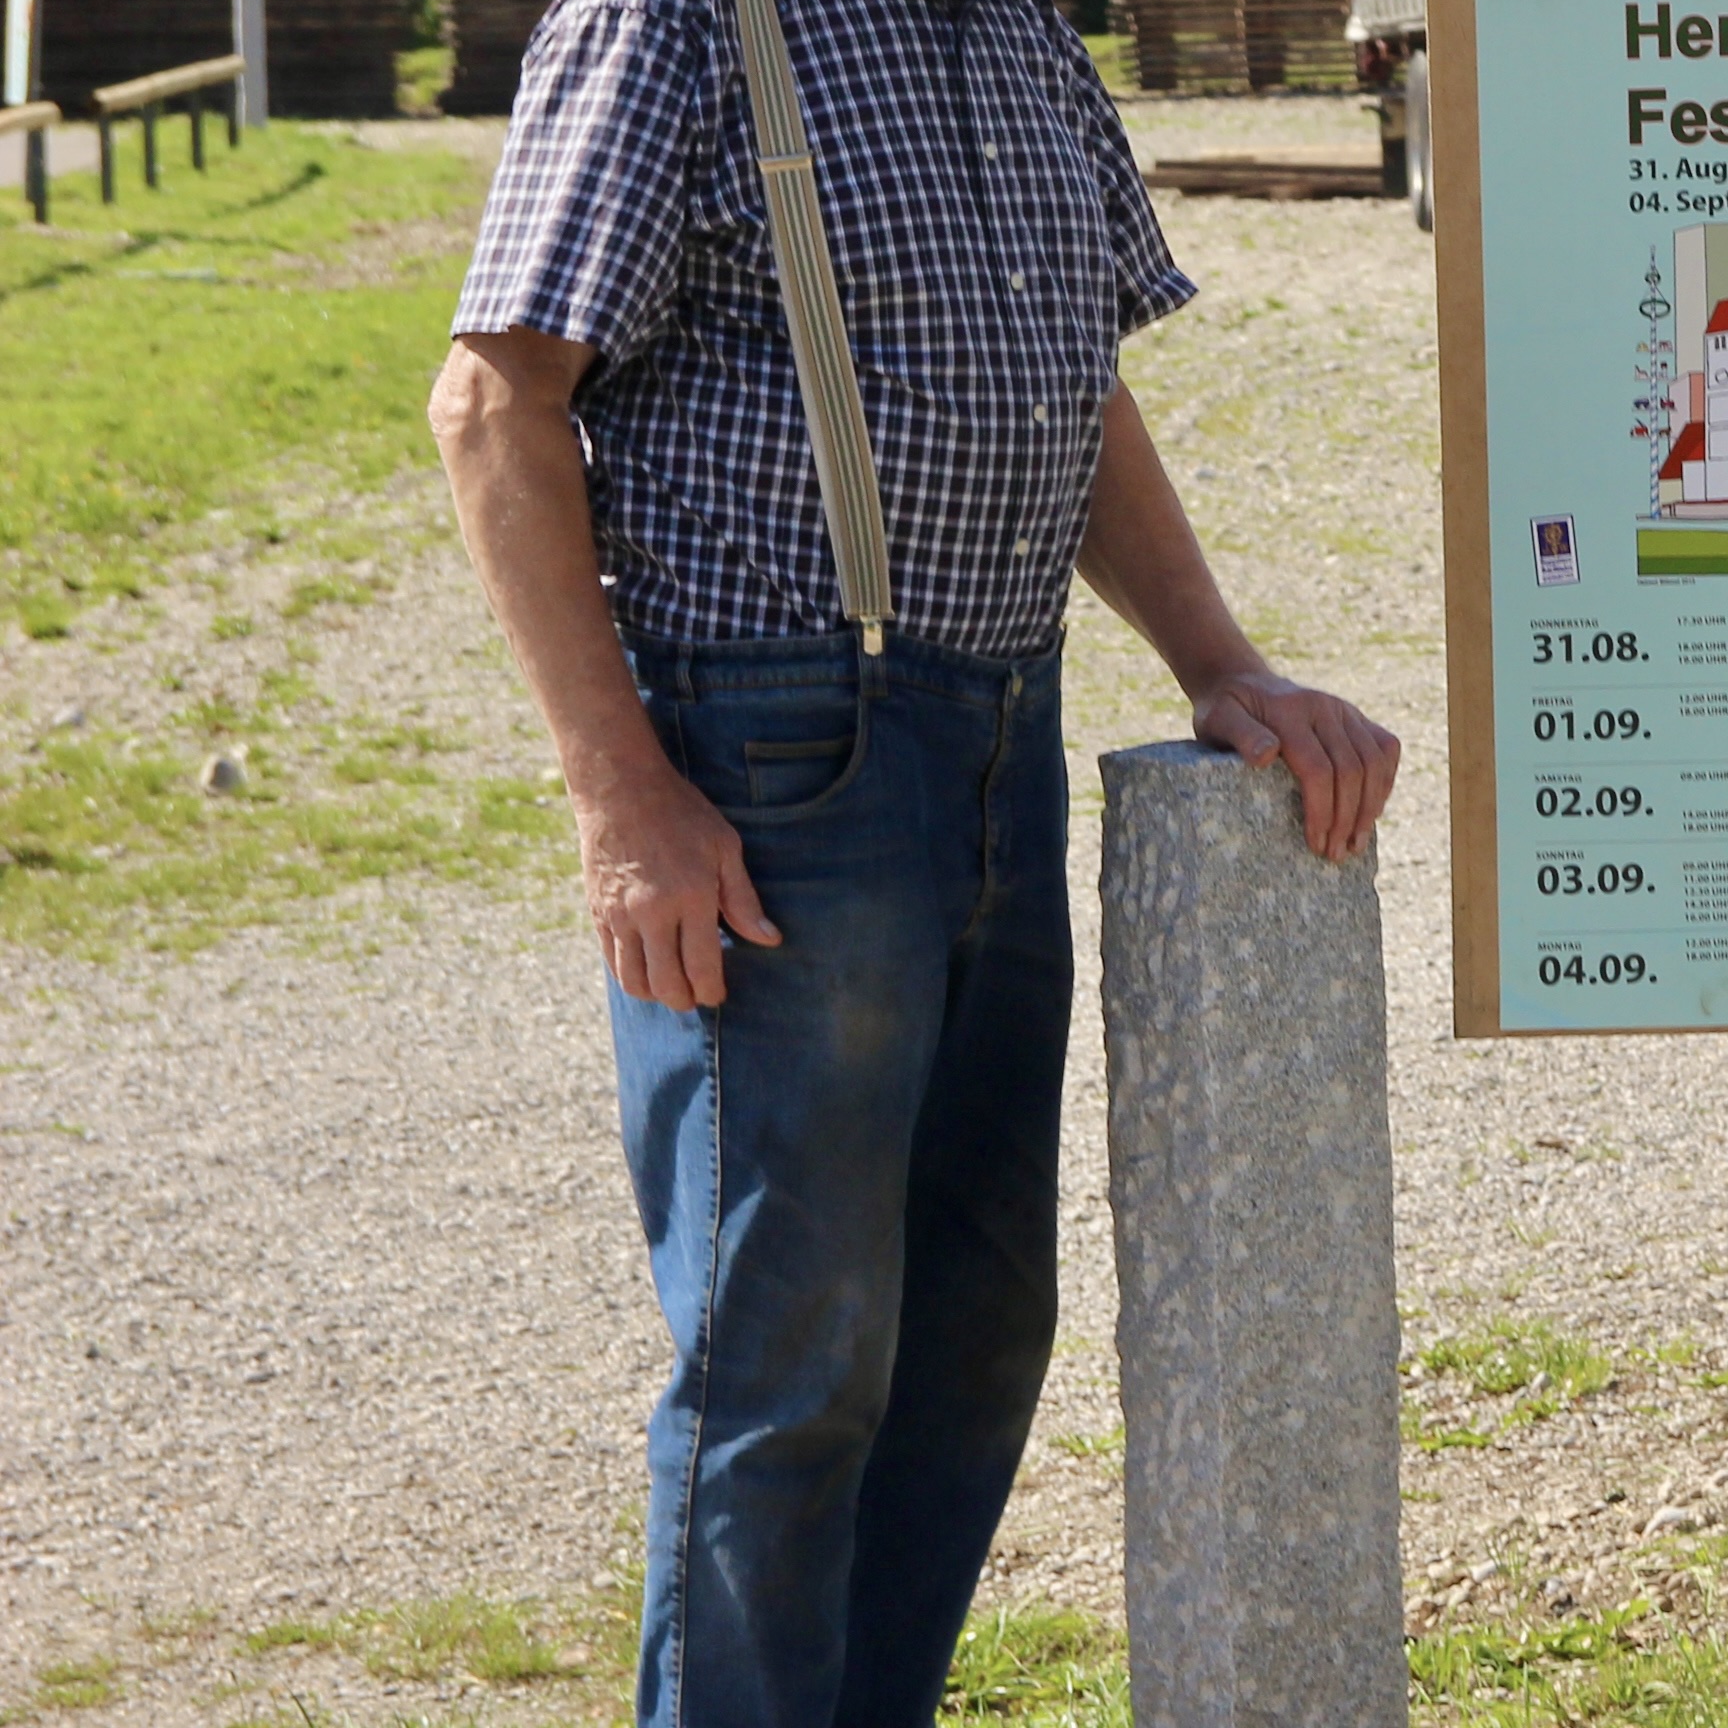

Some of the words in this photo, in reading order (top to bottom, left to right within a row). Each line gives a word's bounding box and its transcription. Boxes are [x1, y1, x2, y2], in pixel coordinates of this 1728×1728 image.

[1628, 157, 1668, 182] 31.
[1628, 188, 1671, 214] 04.
[1530, 617, 1599, 629] DONNERSTAG
[1705, 616, 1726, 626] UHR
[1533, 632, 1650, 663] 31.08.
[1532, 696, 1573, 707] FREITAG
[1534, 708, 1651, 740] 01.09.
[1534, 774, 1582, 784] SAMSTAG
[1536, 786, 1653, 817] 02.09.
[1536, 850, 1584, 861] SONNTAG
[1537, 863, 1655, 895] 03.09.
[1538, 941, 1582, 952] MONTAG
[1539, 953, 1657, 985] 04.09.
